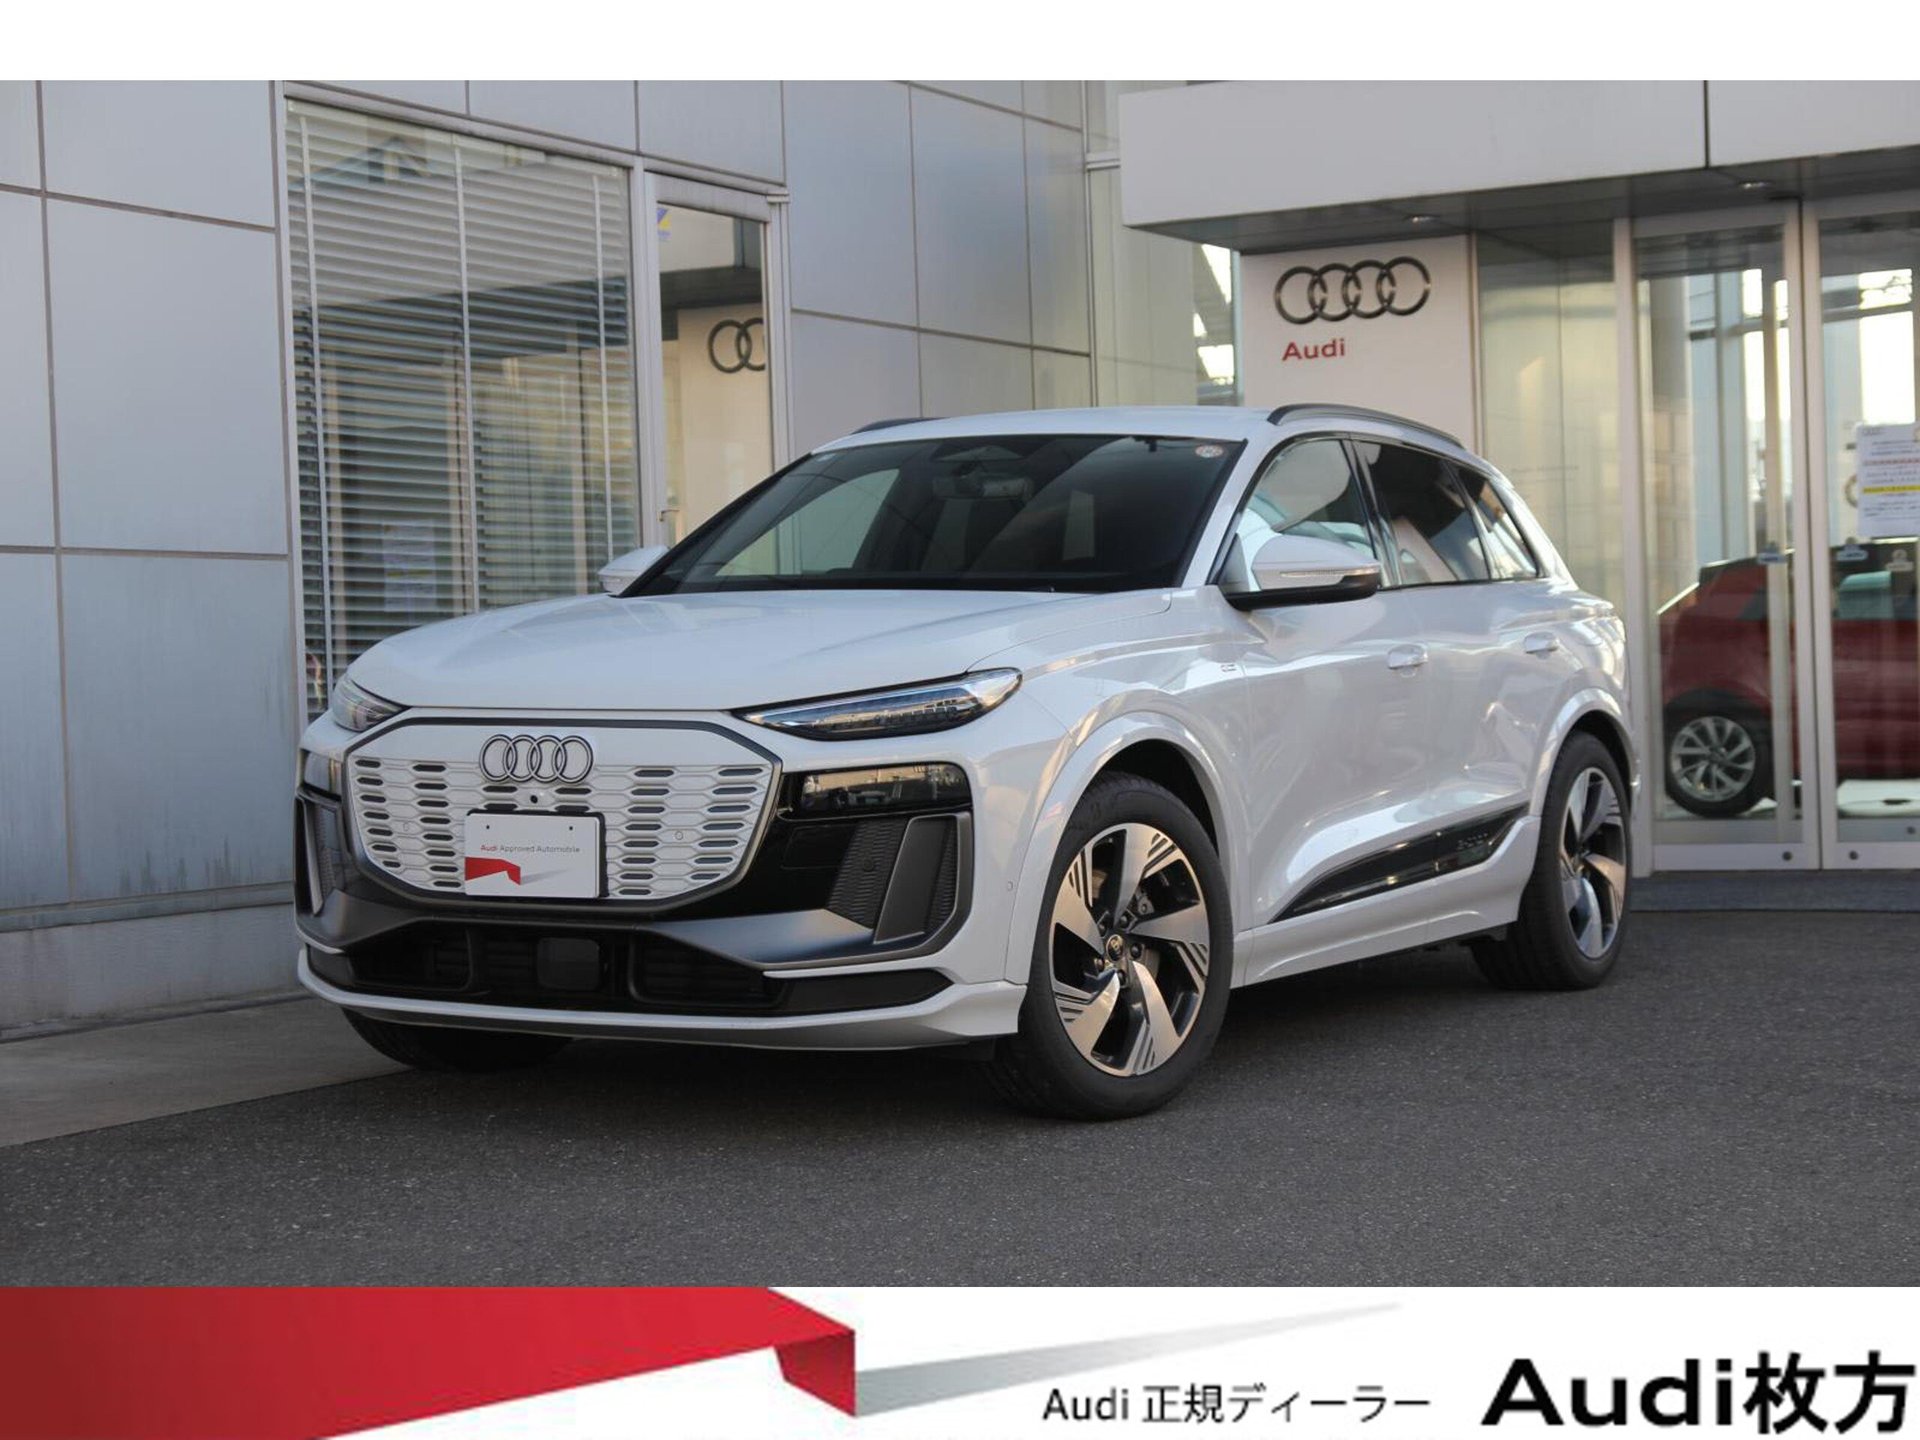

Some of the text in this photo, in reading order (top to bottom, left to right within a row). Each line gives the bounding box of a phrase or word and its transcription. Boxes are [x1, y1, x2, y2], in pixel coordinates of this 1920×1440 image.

[1282, 338, 1345, 361] Audi
[480, 844, 580, 853] Audi Approved Automobile
